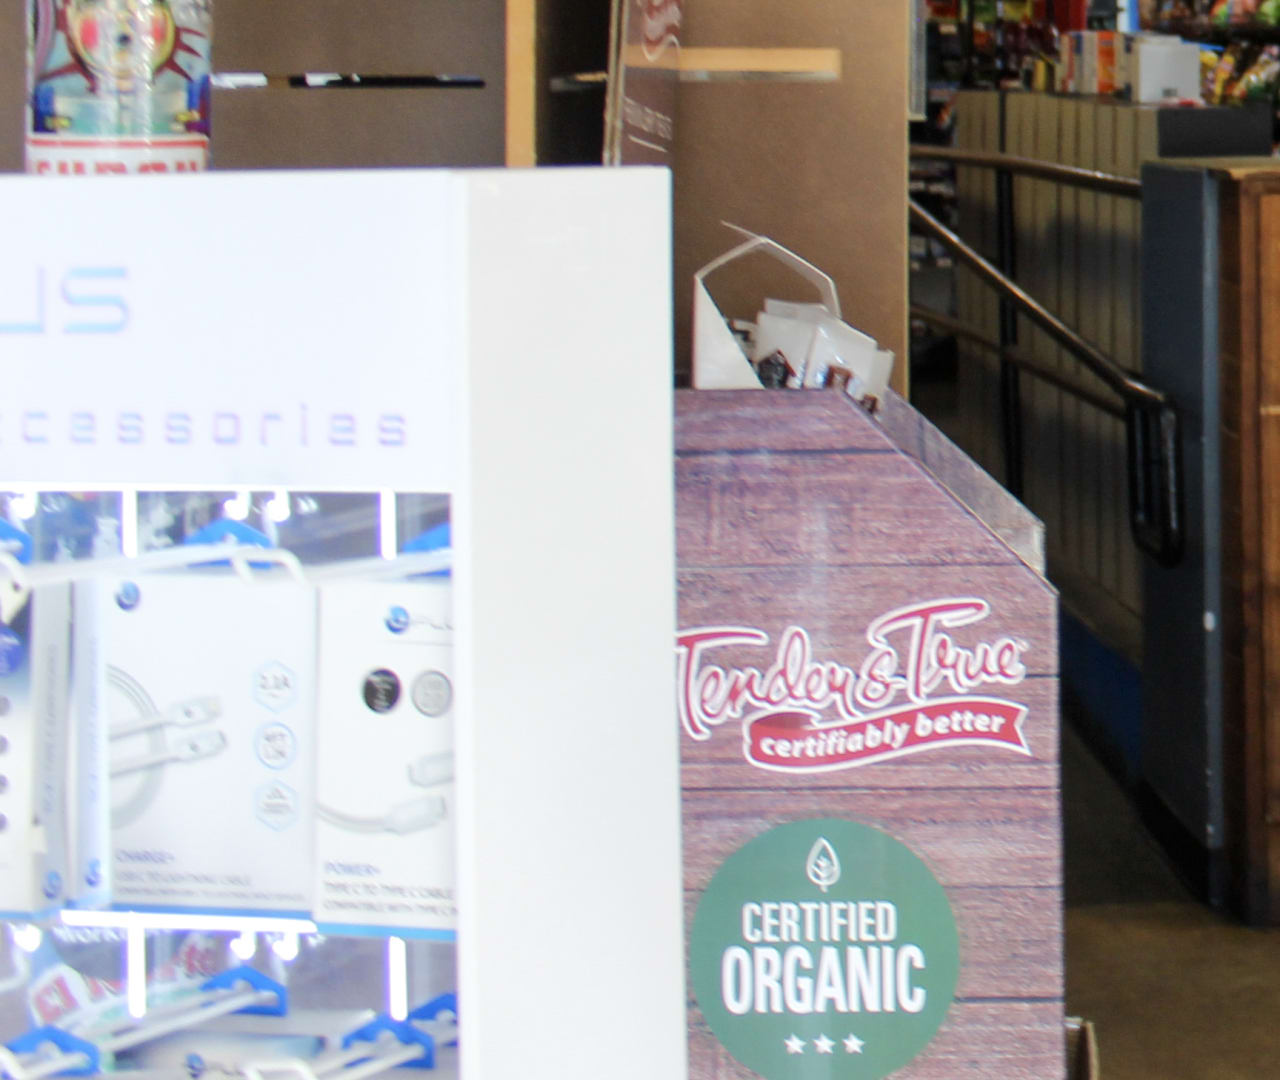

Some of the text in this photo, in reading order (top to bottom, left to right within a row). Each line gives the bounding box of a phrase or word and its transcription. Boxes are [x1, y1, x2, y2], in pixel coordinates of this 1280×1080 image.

[673, 624, 866, 741] Tender
[868, 598, 1028, 704] True
[758, 712, 1007, 760] certifiably better
[742, 901, 897, 943] CERTIFIED
[721, 944, 927, 1015] ORGANIC
